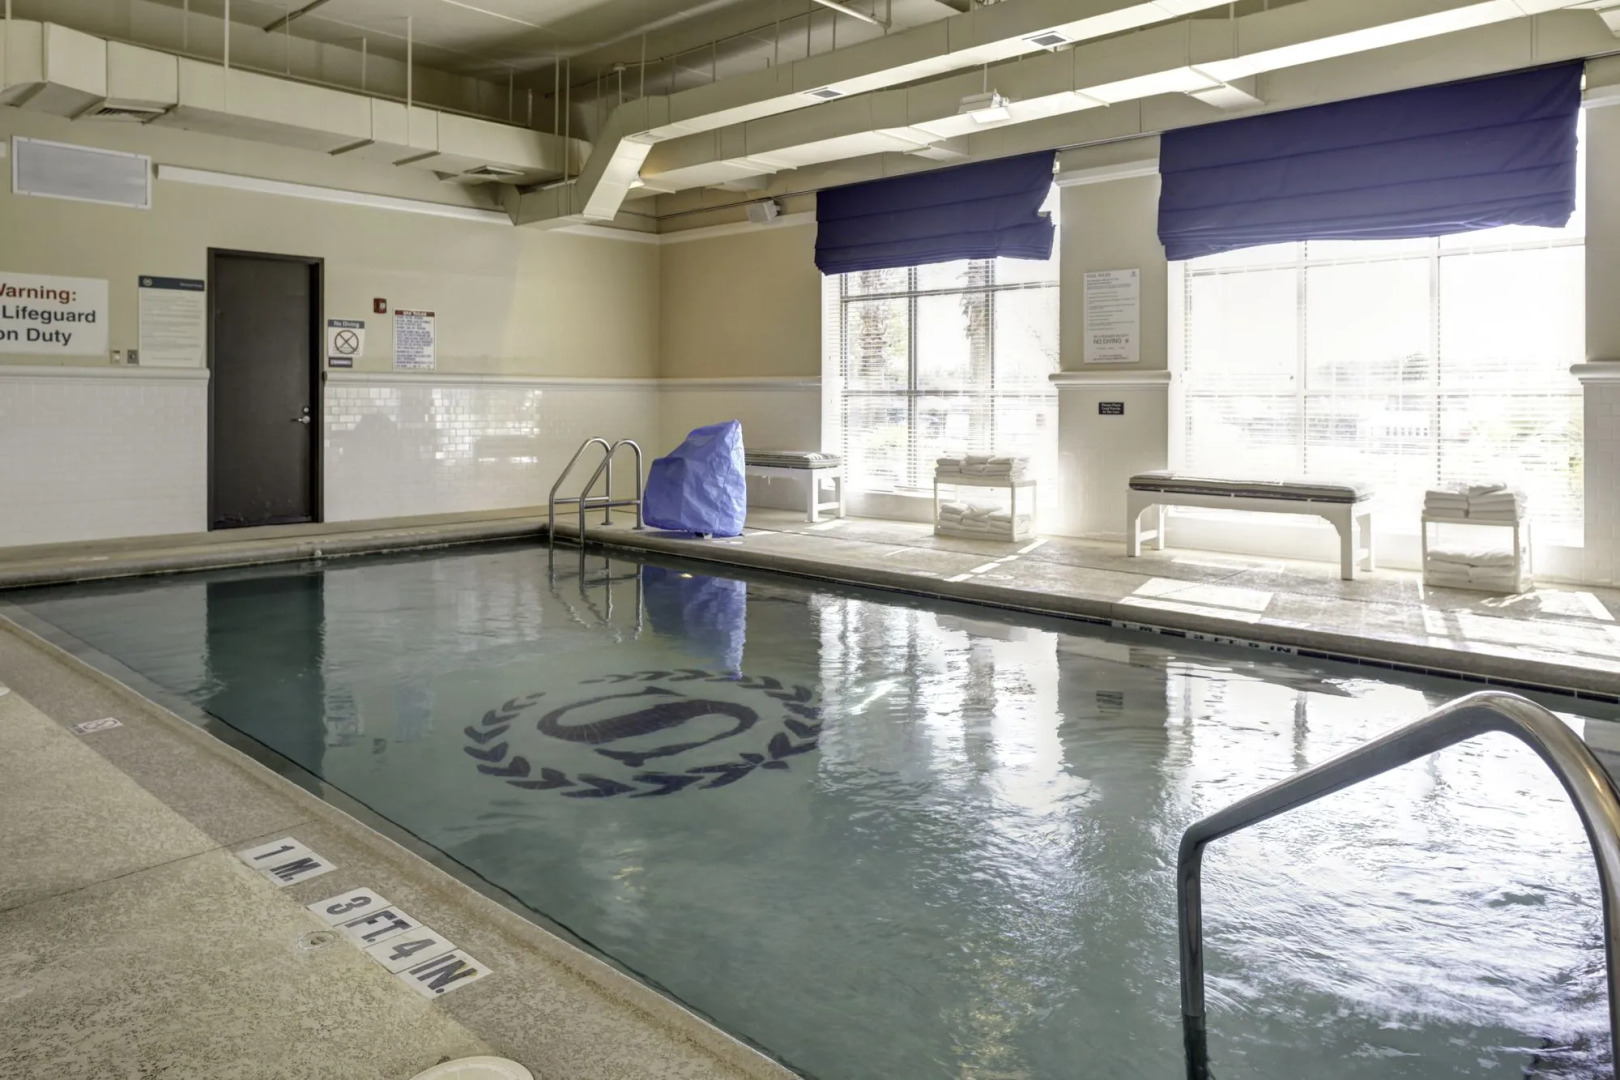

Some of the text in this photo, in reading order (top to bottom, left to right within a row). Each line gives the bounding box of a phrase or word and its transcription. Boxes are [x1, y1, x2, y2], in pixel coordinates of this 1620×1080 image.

[2, 305, 96, 325] Lifeguard
[342, 321, 360, 329] Diving
[26, 327, 72, 347] Duty
[1270, 645, 1291, 654] IN
[253, 845, 295, 861] 1
[326, 896, 478, 994] 3 FT. 4 IN.
